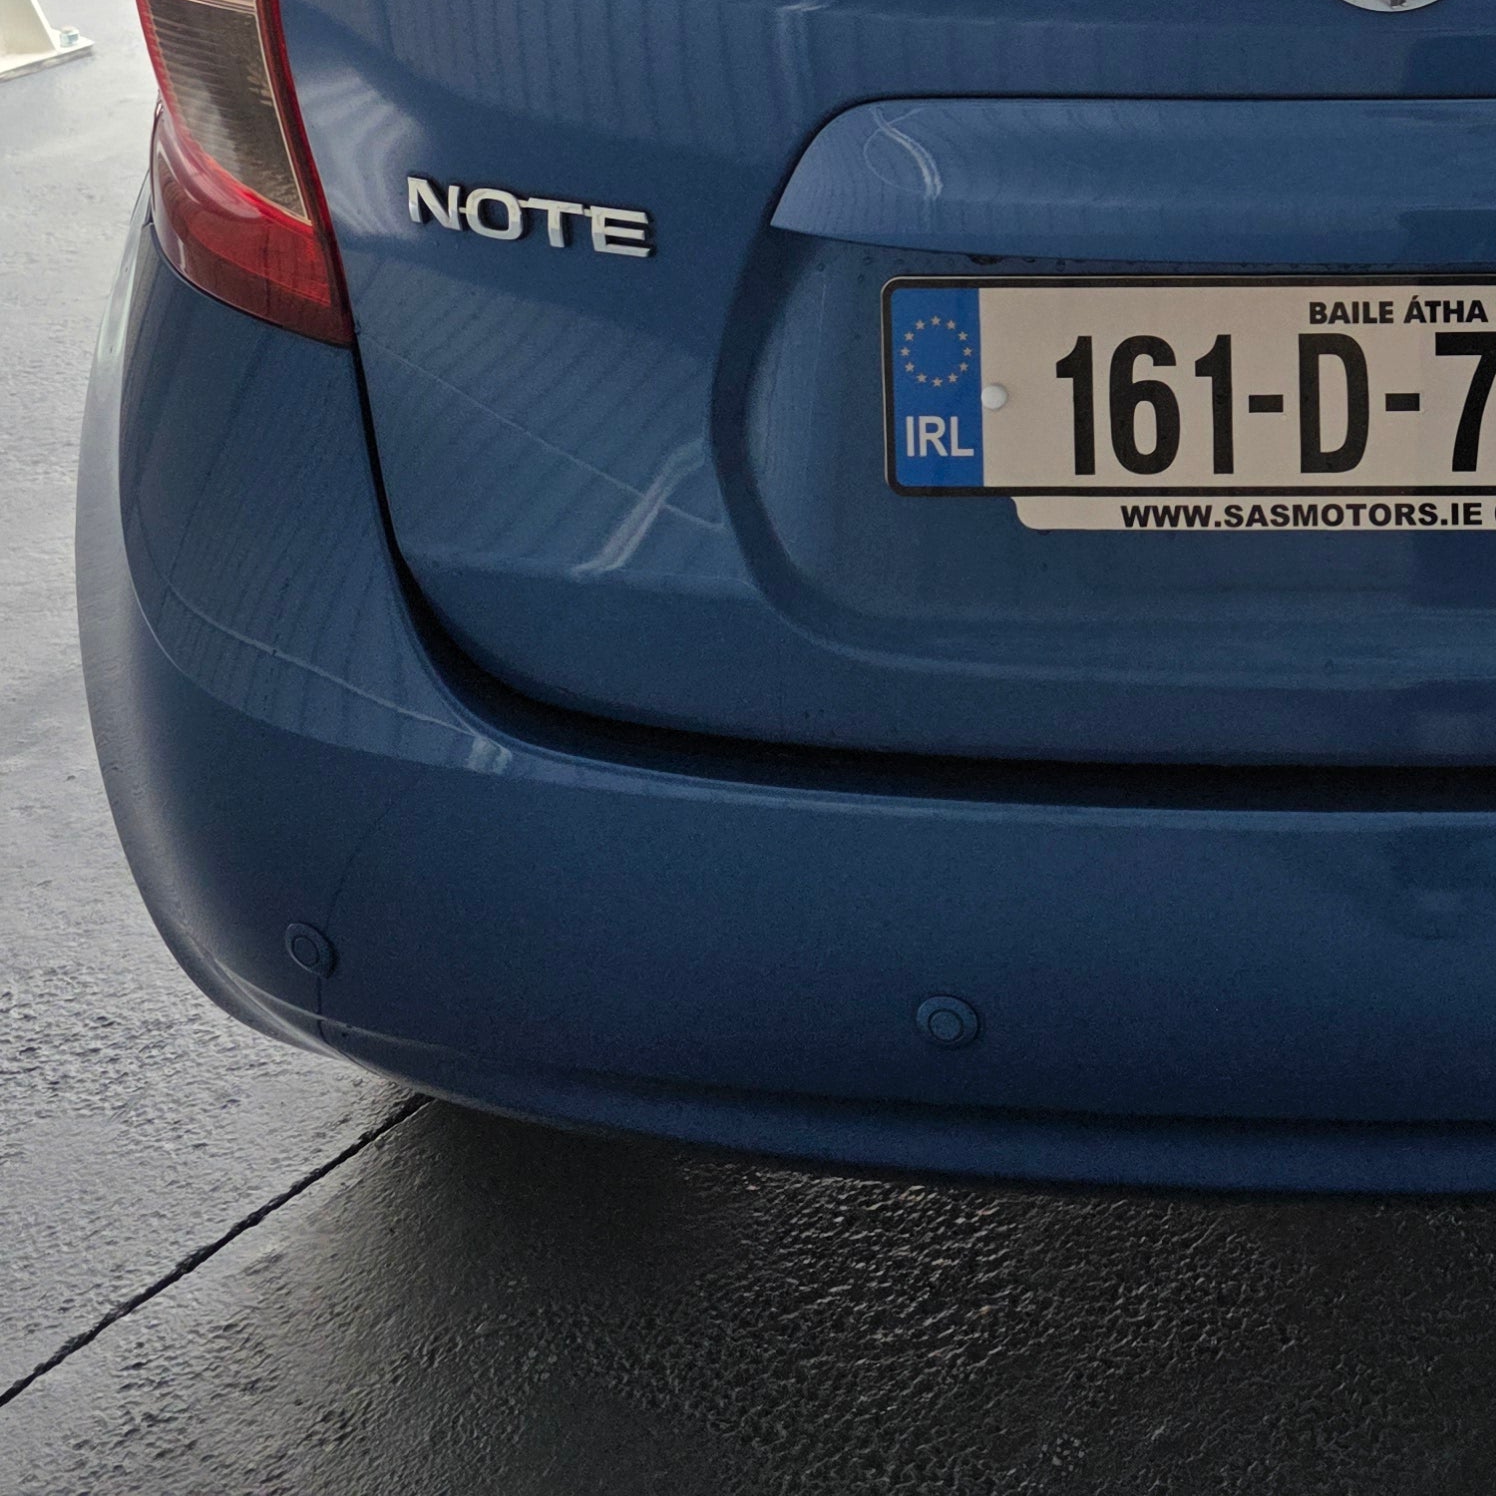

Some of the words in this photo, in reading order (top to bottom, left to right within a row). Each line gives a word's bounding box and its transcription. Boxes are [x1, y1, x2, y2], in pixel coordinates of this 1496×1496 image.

[406, 176, 652, 258] NOTE
[1308, 300, 1395, 325] BAILE
[1403, 294, 1489, 324] ÁTHA
[905, 415, 975, 458] IRL
[1120, 502, 1484, 528] WWW.SASMOTORS.IE
